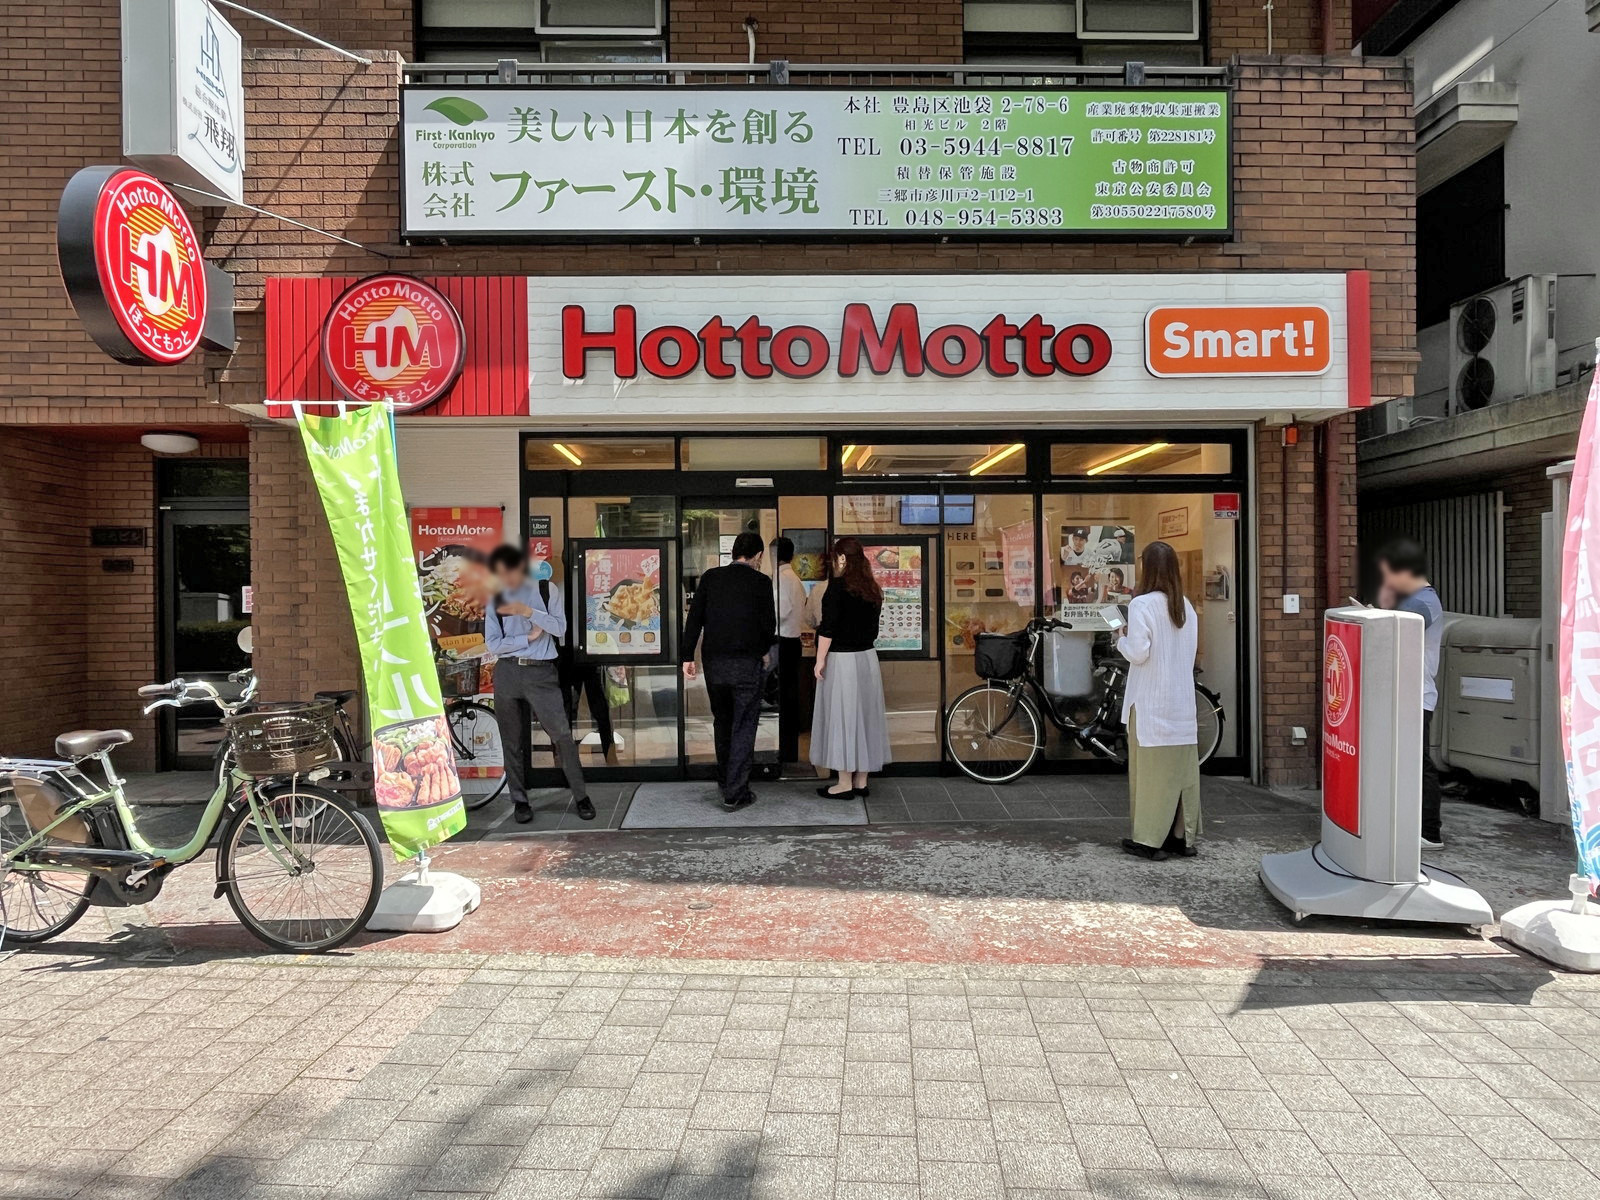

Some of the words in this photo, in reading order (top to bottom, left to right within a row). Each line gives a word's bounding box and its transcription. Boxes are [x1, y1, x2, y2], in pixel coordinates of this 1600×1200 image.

[844, 96, 881, 114] 本社
[893, 96, 992, 114] 豊島区池袋
[1002, 97, 1068, 113] 2-78-6
[1087, 103, 1220, 116] 産業廃棄物収集運搬業
[507, 106, 814, 145] 美しい日本を創る
[905, 119, 968, 131] 相光ビル
[982, 119, 1008, 131] 2階
[204, 110, 236, 162] 飛翔
[1092, 130, 1140, 143] 許可番号
[1149, 130, 1214, 143] 第228181号
[432, 142, 477, 150] Corporation
[837, 137, 881, 156] TEL
[900, 137, 1074, 156] 03-5944-8817
[896, 166, 1016, 180] 積替保管施設
[1113, 160, 1194, 173] 古物商許可
[421, 161, 475, 187] 株式
[1097, 182, 1210, 196] 東京公安委員会
[423, 192, 475, 219] 会社
[1091, 205, 1214, 218] 第305502217580号
[849, 209, 889, 226] TEL
[905, 209, 1063, 226] 048-954-5383
[127, 303, 191, 352] ほっともっと
[1163, 320, 1315, 359] Smart!
[947, 532, 977, 541] HERE
[462, 636, 478, 644] Fair
